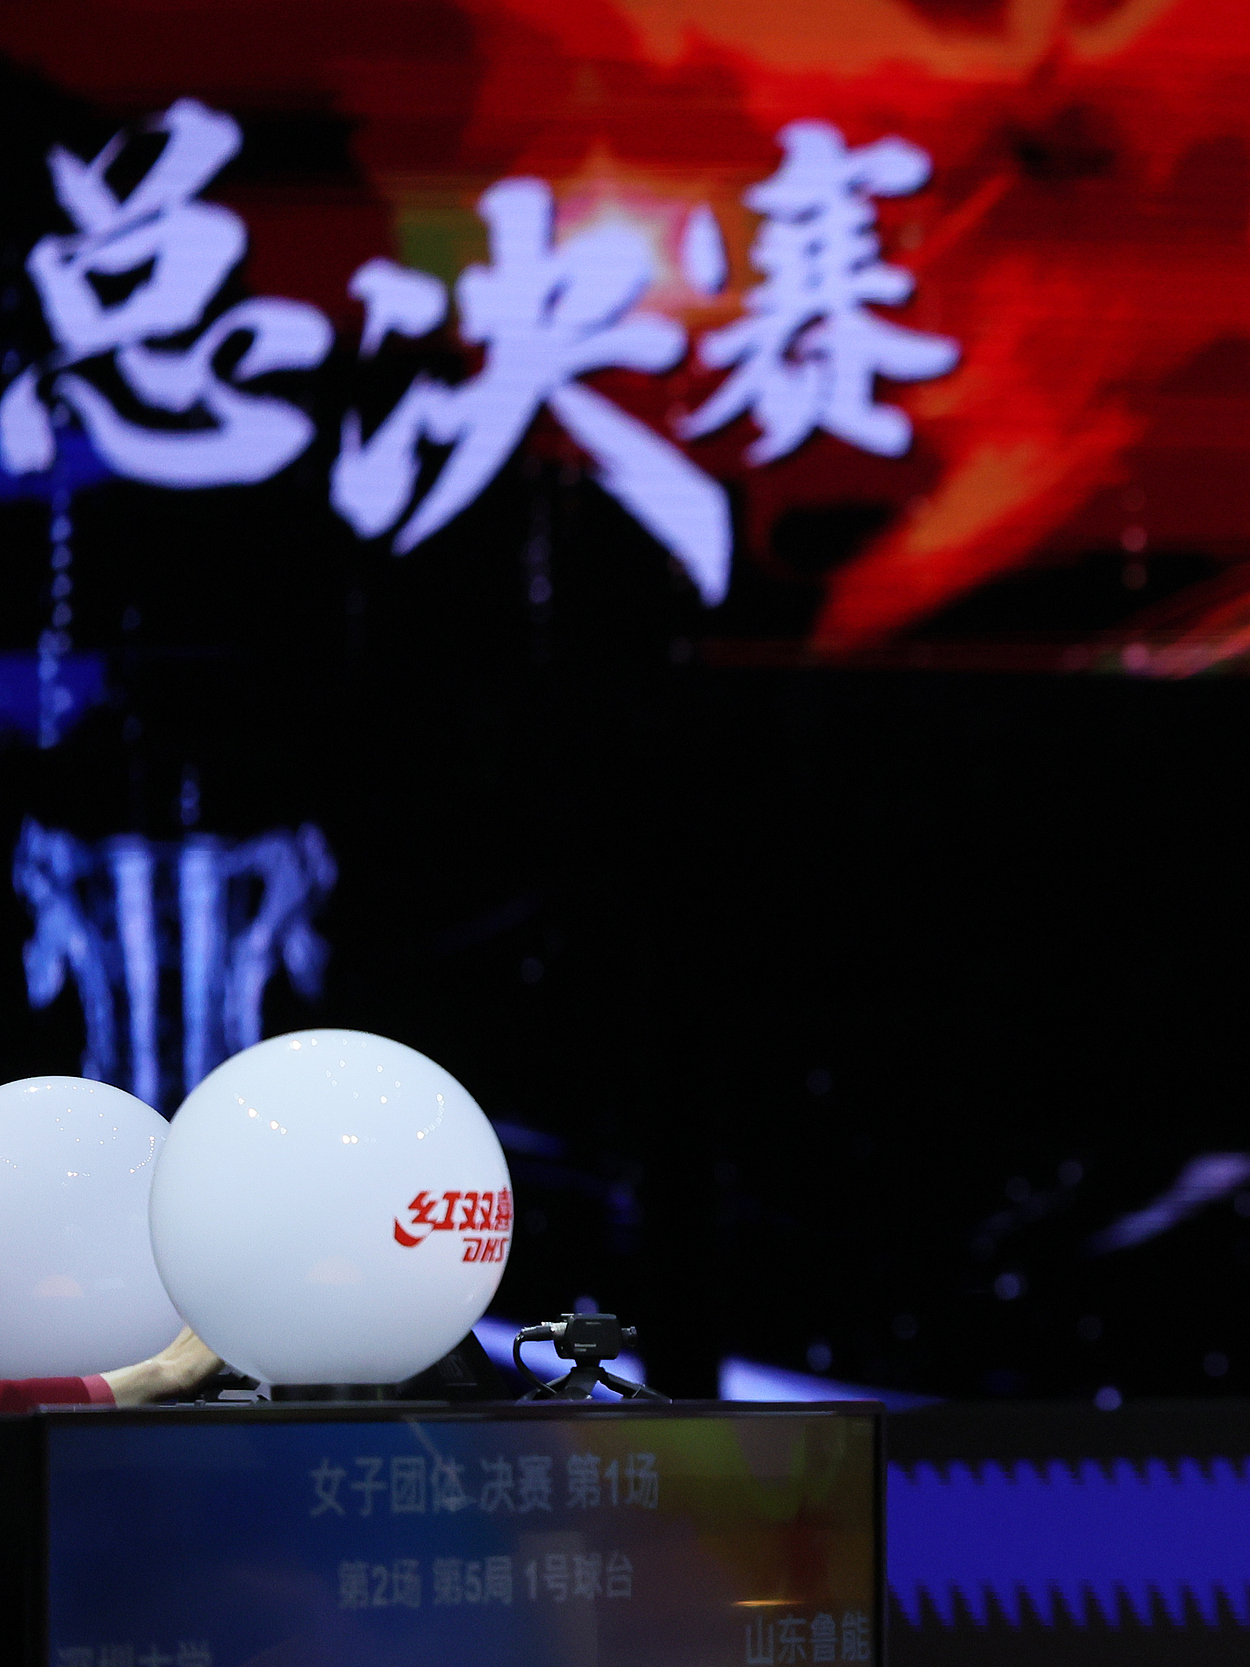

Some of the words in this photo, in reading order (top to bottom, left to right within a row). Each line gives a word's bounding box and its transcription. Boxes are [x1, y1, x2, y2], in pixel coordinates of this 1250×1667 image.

[0, 97, 959, 606] 总决赛
[309, 1455, 468, 1518] 女子团体
[479, 1454, 552, 1514] 决赛
[565, 1451, 659, 1510] 第1场
[338, 1558, 421, 1608] 第2场
[432, 1555, 513, 1604] 第5局
[524, 1551, 634, 1602] 1号球台
[744, 1611, 870, 1665] 山东鲁能
